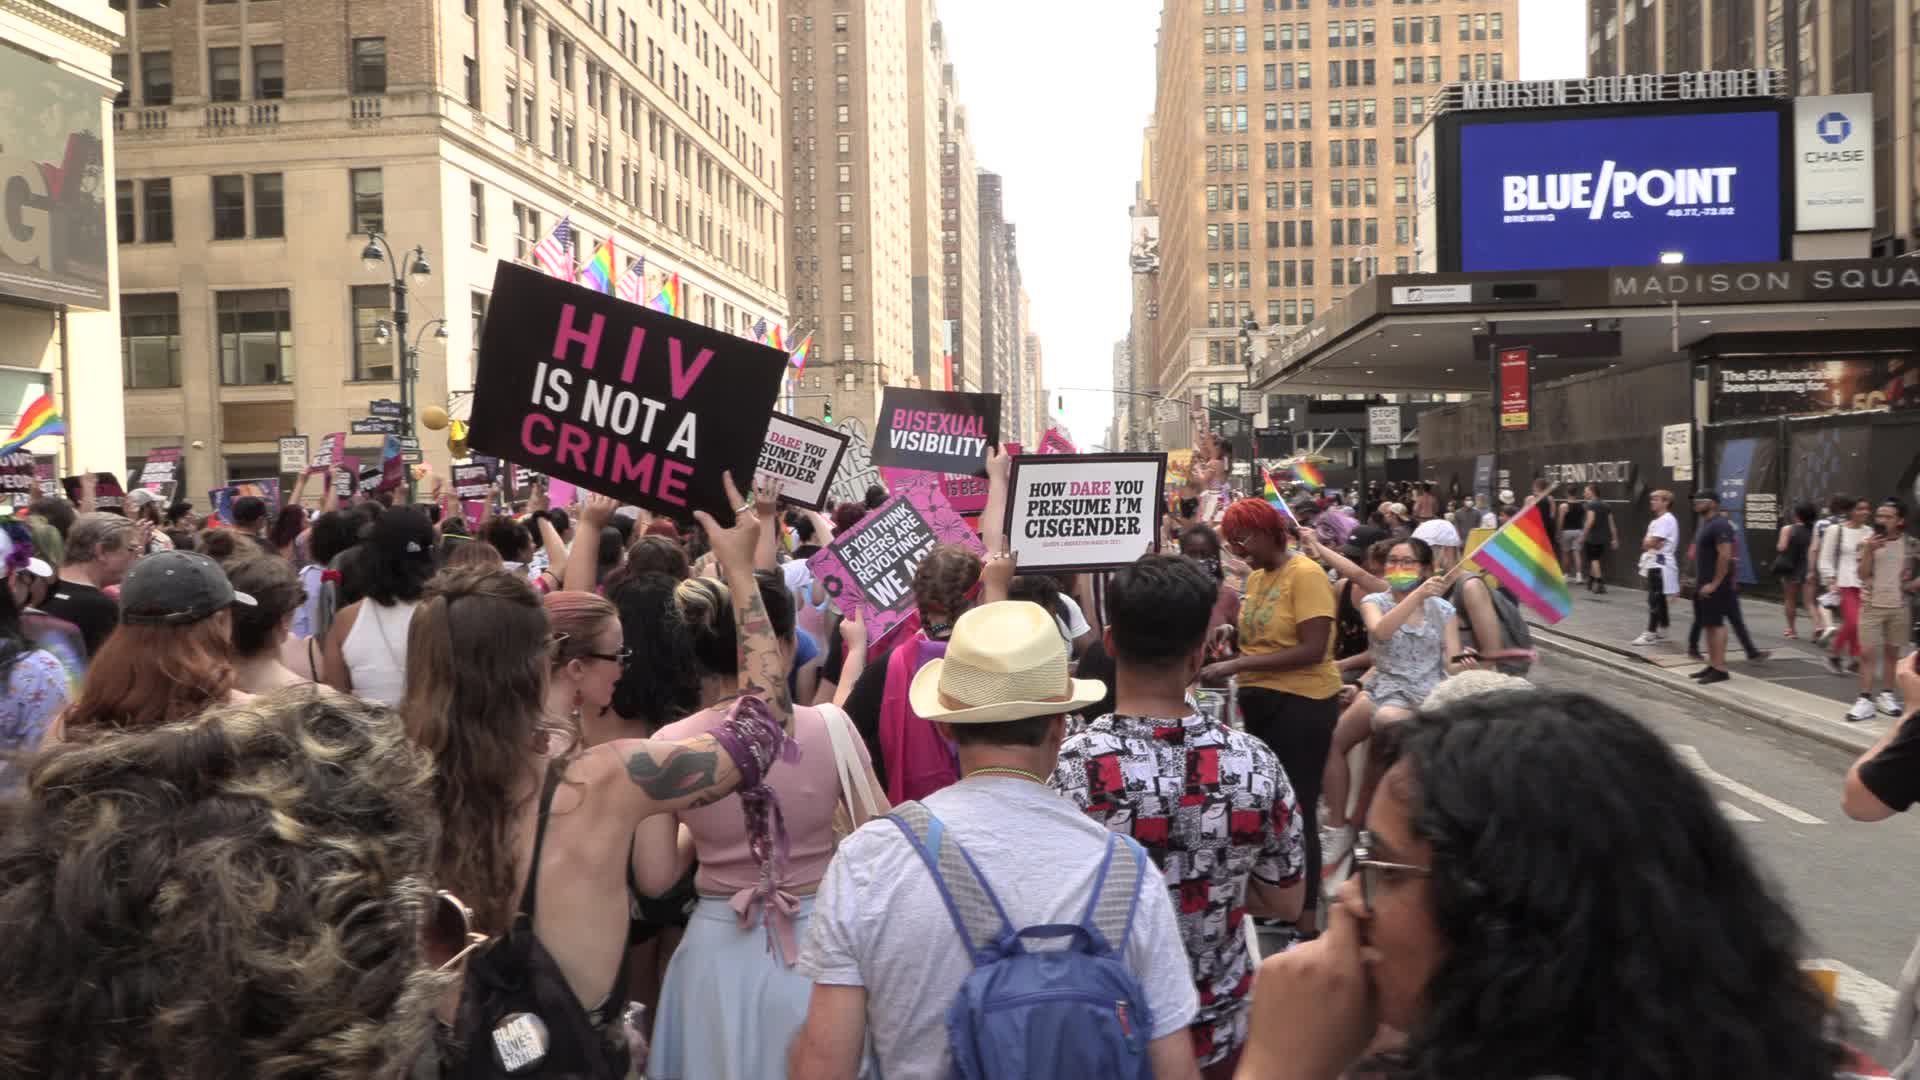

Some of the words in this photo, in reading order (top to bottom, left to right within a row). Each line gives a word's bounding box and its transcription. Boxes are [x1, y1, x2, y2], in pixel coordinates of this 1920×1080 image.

[1463, 80, 1565, 110] MADISON
[1579, 74, 1664, 104] SQUARE
[1680, 70, 1770, 100] GARDEN
[1805, 150, 1864, 163] CHASE
[1503, 214, 1555, 224] BREWING
[1614, 272, 1790, 296] MADISON
[1812, 268, 1920, 289] SQUA
[552, 303, 715, 400] HIV
[1720, 370, 1747, 382] The
[1749, 370, 1768, 380] 5G
[1722, 382, 1757, 392] been
[1758, 381, 1805, 394] waiting
[531, 361, 573, 413] IS
[580, 378, 666, 445] NOT
[666, 411, 697, 459] A
[892, 408, 988, 438] BISEXUAL
[1371, 408, 1397, 418] STOP
[282, 440, 304, 449] STOP
[770, 432, 802, 450] DARE
[804, 442, 827, 458] YOU
[890, 429, 988, 458] VISIBILITY
[520, 413, 695, 507] CRIME
[800, 455, 822, 471] I'M
[1028, 482, 1066, 498] HOW
[1070, 481, 1111, 496] DARE
[1114, 480, 1144, 495] YOU
[1026, 499, 1111, 517] PRESUME
[1114, 498, 1142, 514] I'M
[840, 545, 852, 561] IF
[850, 528, 877, 551] YOU
[873, 504, 911, 534] THINK
[1025, 516, 1141, 538] CISGENDER
[848, 532, 896, 573] QUEERS
[894, 514, 920, 539] ARE
[856, 532, 930, 585] REVOLTING...
[868, 569, 910, 607] WE
